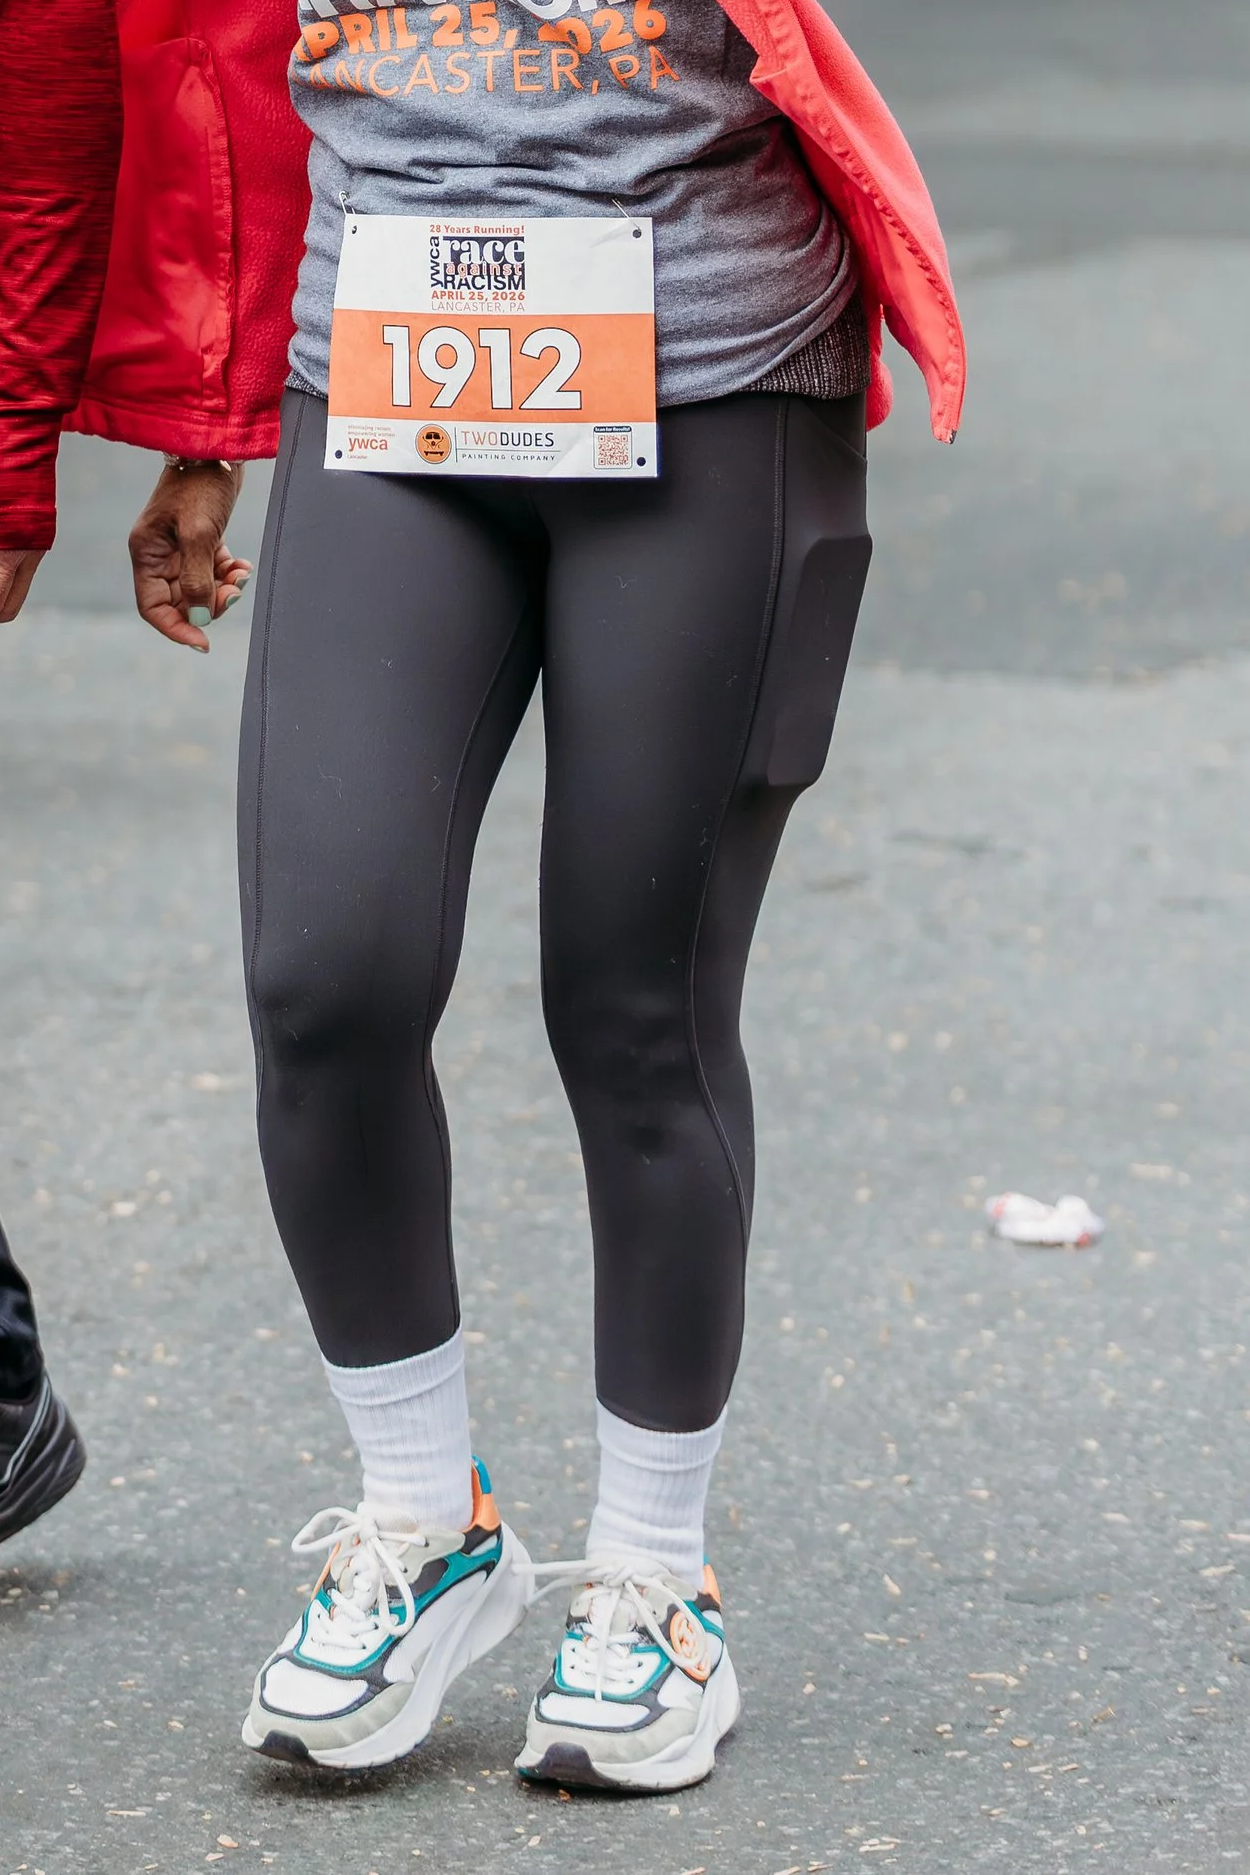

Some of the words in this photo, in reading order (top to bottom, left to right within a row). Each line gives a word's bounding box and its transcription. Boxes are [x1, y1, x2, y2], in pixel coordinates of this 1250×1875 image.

[430, 0, 519, 49] 25,
[608, 44, 681, 91] PA
[430, 224, 441, 233] 28
[444, 225, 471, 234] Years
[474, 224, 525, 235] Running!
[443, 239, 526, 265] race
[430, 236, 444, 288] ywca
[445, 261, 523, 279] against
[443, 274, 526, 291] RACISM
[431, 290, 465, 300] APRIL
[468, 291, 488, 302] 25,
[492, 291, 525, 301] 2026
[431, 301, 505, 313] LANCASTER,
[510, 302, 525, 312] PA
[382, 324, 582, 410] 1912
[349, 437, 388, 452] ywca
